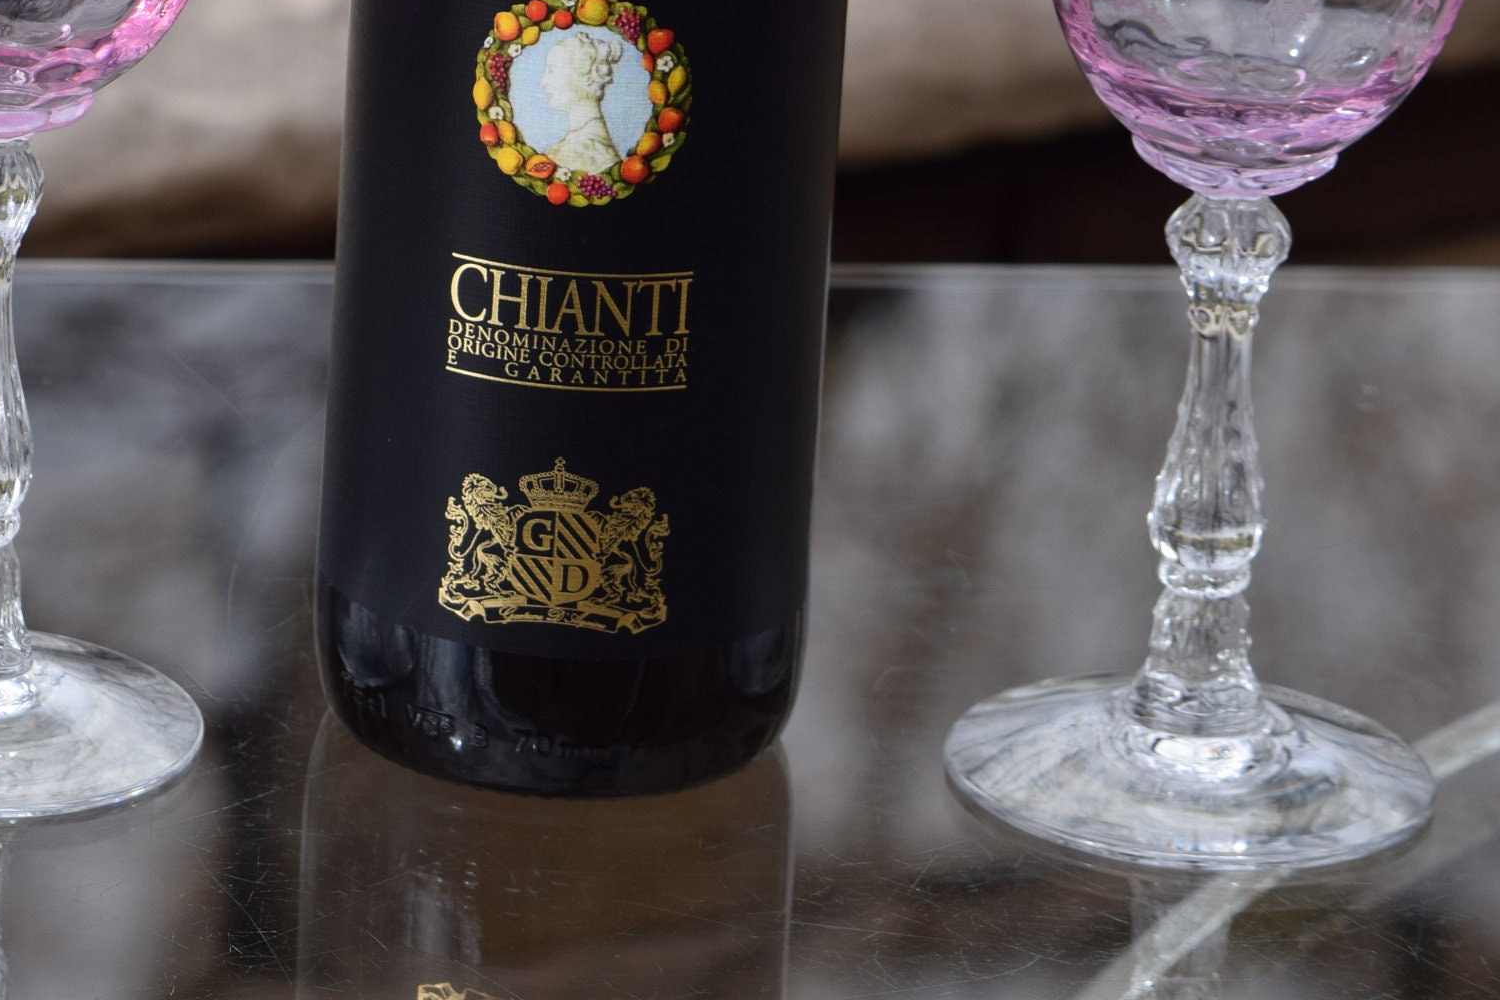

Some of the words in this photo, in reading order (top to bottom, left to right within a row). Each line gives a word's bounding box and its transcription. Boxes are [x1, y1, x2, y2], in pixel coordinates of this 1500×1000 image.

[450, 262, 694, 338] CHIANTI
[448, 334, 531, 364] ORIGINE
[539, 350, 688, 371] CONTROLLATA
[449, 318, 647, 355] DENOMINAZIONE
[666, 337, 689, 353] DI
[447, 348, 458, 365] E
[505, 361, 687, 385] GARANTITA
[522, 518, 553, 551] G
[560, 563, 589, 594] D
